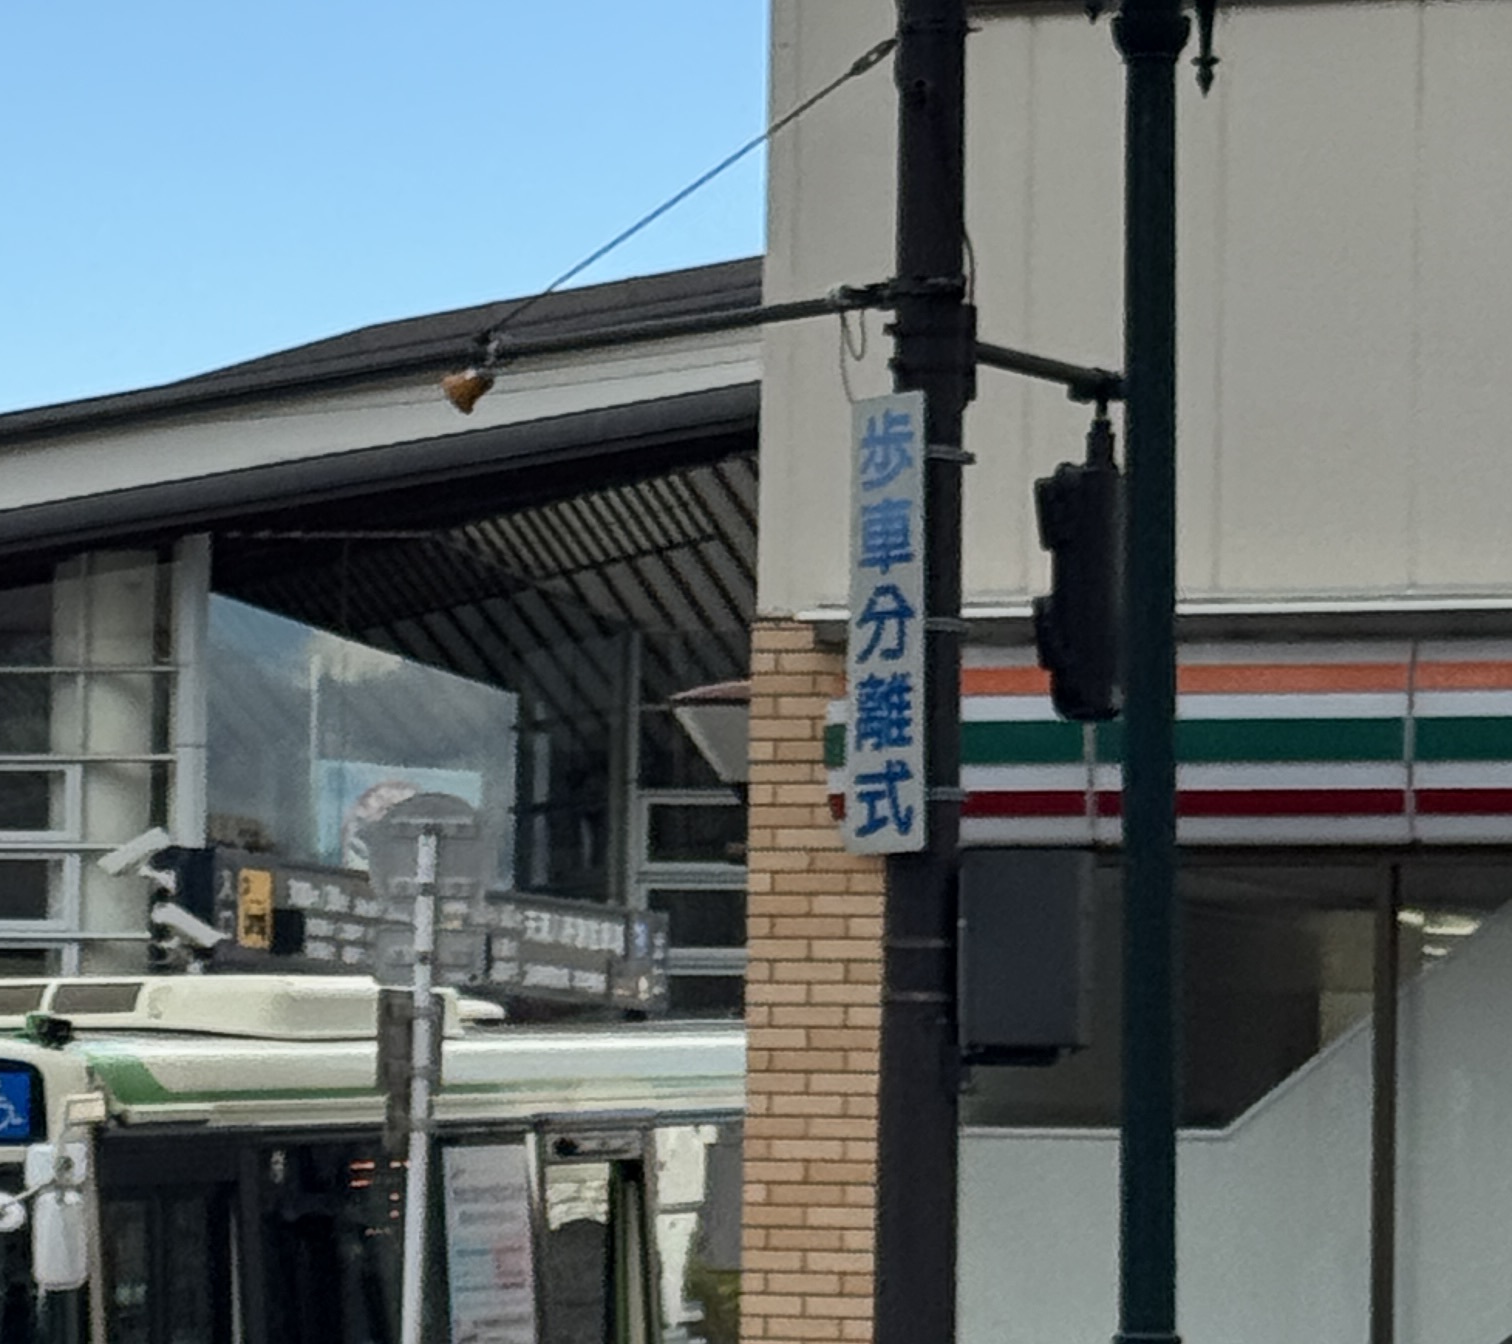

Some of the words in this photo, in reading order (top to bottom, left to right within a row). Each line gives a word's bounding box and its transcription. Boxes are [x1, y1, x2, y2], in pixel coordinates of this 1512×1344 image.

[855, 409, 915, 837] 歩車分離式
